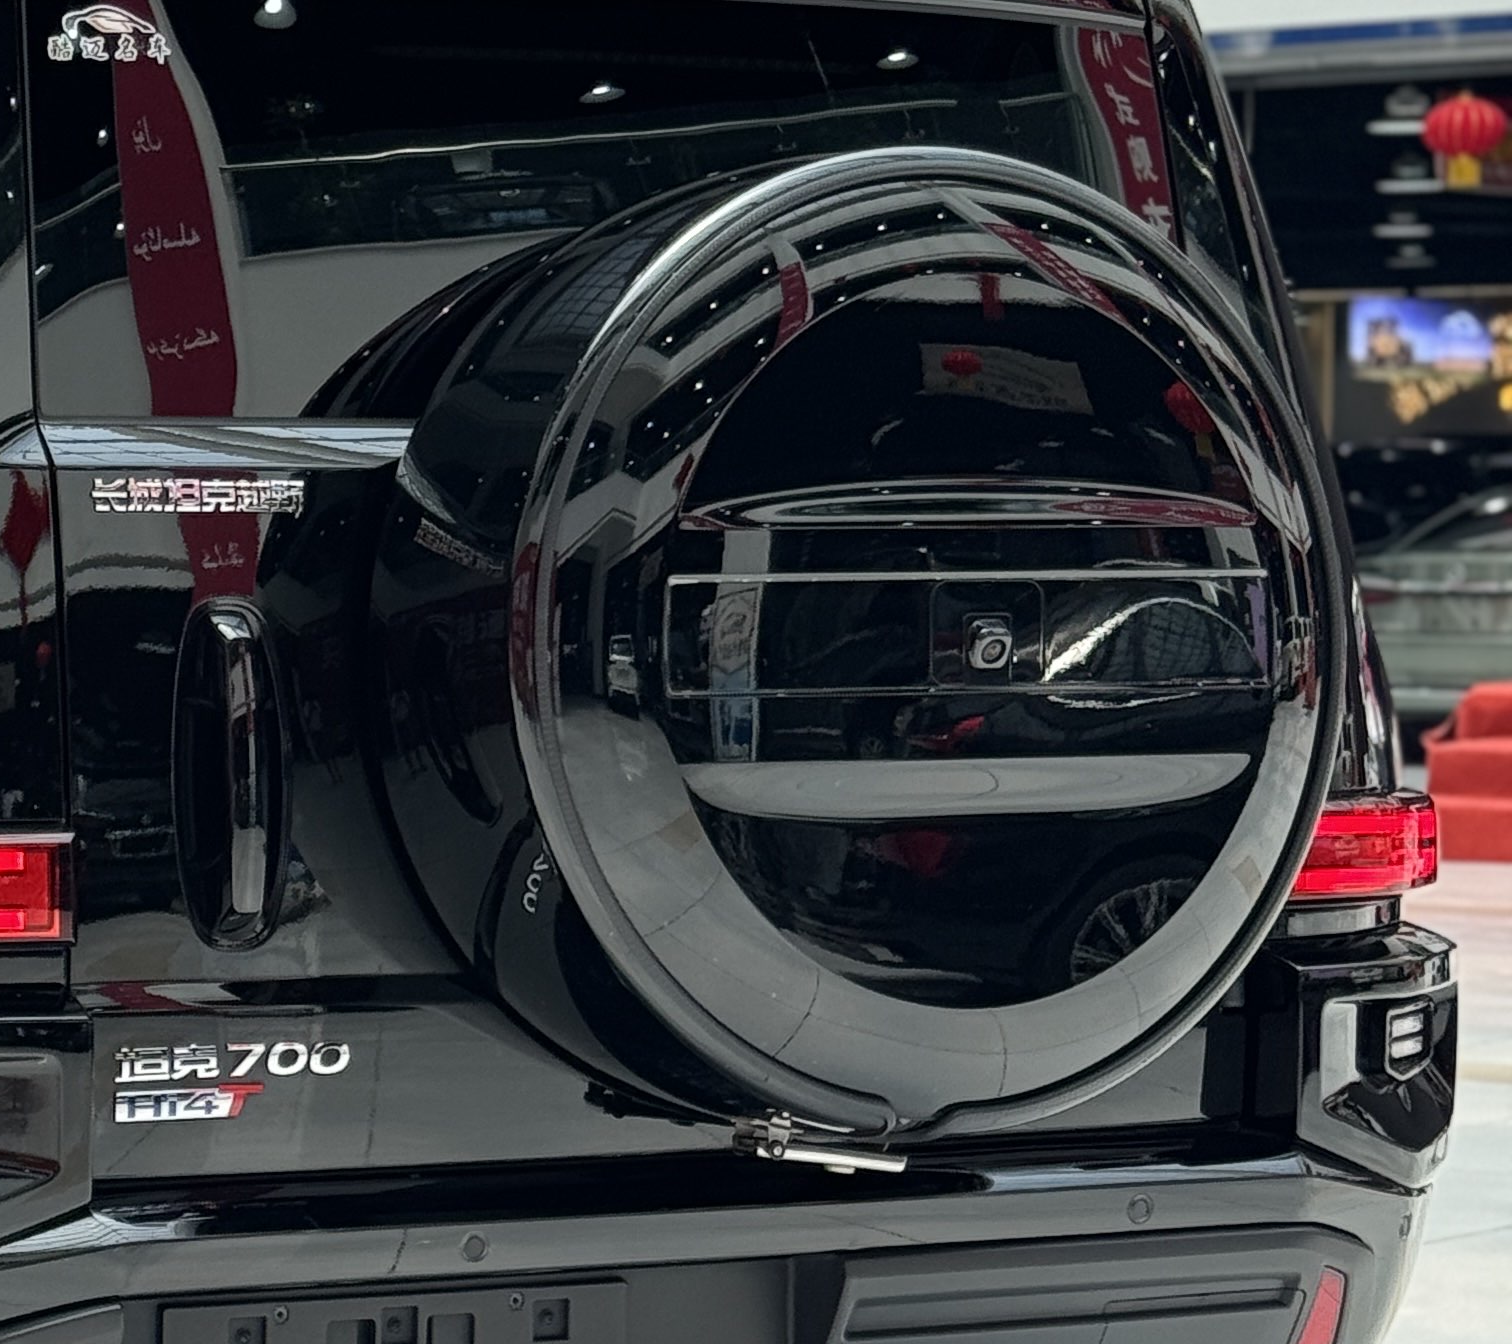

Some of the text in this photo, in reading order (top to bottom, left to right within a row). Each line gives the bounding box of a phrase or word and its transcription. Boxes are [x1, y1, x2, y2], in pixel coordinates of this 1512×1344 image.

[91, 477, 305, 520] 长城坦克越野
